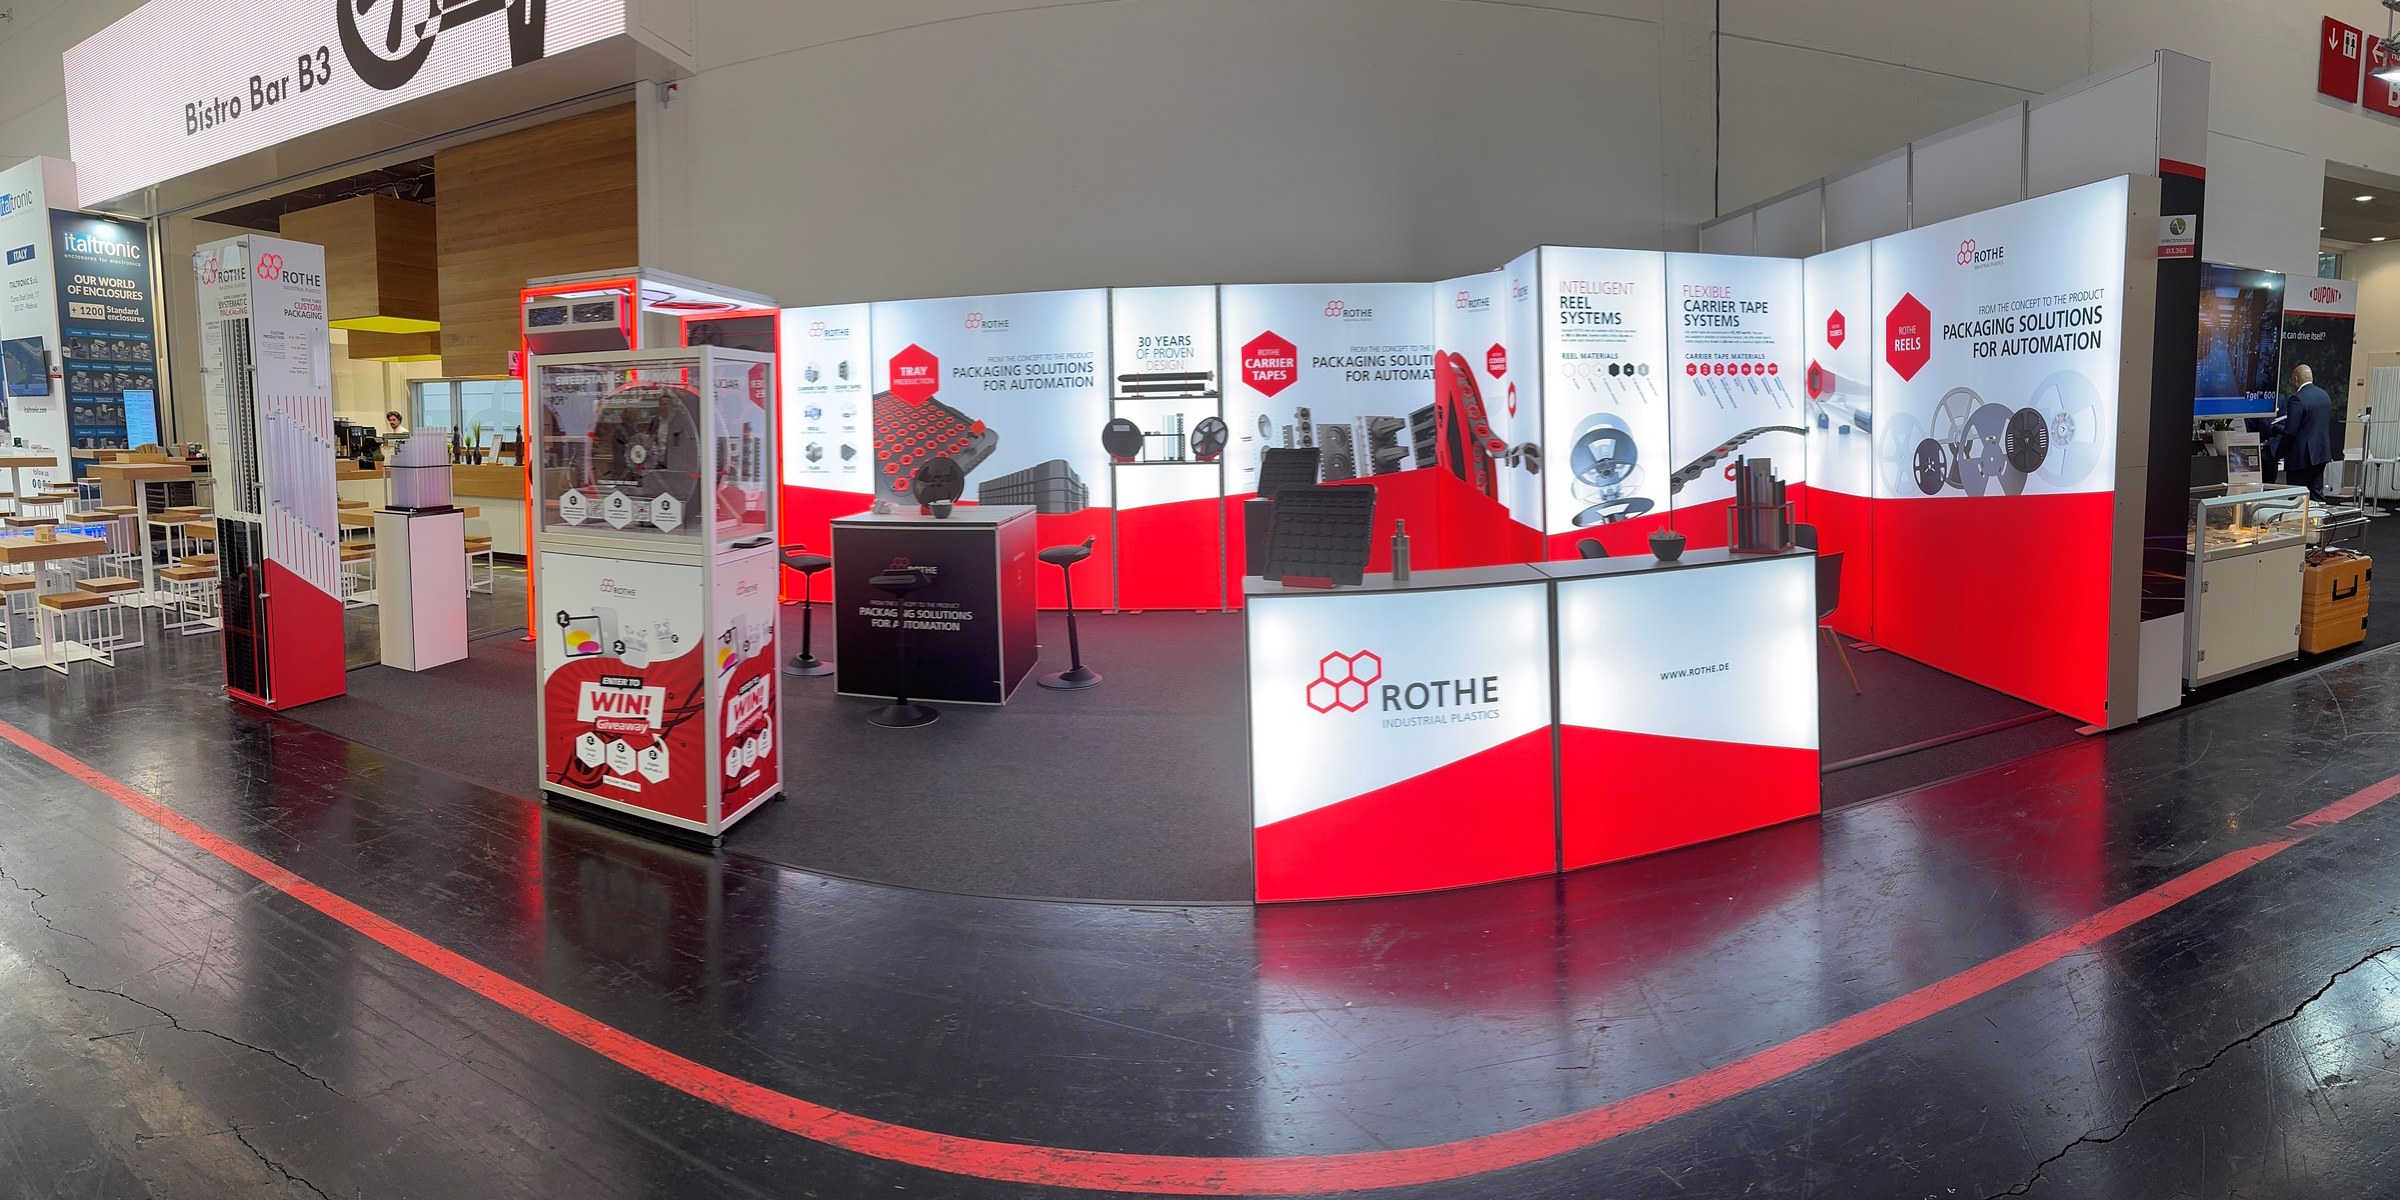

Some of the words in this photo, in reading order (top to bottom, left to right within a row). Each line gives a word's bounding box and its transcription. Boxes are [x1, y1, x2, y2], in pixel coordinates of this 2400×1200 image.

[185, 96, 241, 136] Bistro
[250, 75, 289, 112] Bar
[298, 46, 331, 92] B3
[64, 232, 140, 259] italtronic
[13, 248, 28, 261] ITALY
[64, 253, 97, 261] enclosures
[110, 258, 141, 267] electronics
[1974, 246, 2004, 263] ROTHE
[74, 274, 97, 285] OUR
[99, 276, 135, 289] WORLD
[218, 268, 245, 283] ROTHE
[282, 270, 320, 287] ROTHE
[68, 285, 82, 295] OF
[83, 286, 143, 300] ENCLOSURES
[1560, 281, 1634, 294] INTELLIGENT
[1683, 285, 1731, 298] FLEXIBLE
[1978, 306, 1996, 315] FROM
[1998, 303, 2009, 313] THE
[2011, 298, 2040, 311] CONCEPT
[2043, 297, 2052, 306] TO
[2054, 294, 2067, 305] THE
[2069, 288, 2104, 302] PRODUCT
[2312, 286, 2339, 304] DUPONT
[219, 298, 247, 309] SYSTEMATC
[294, 302, 322, 312] CUSTOM
[1468, 298, 1490, 308] ROTHE
[1560, 296, 1591, 309] REEL
[1684, 300, 1736, 313] CARRIER
[1739, 301, 1768, 313] TAPE
[80, 306, 103, 316] 1200
[106, 305, 139, 316] Standard
[220, 307, 247, 316] PACKAGING
[284, 309, 322, 320] PACKAGING
[1343, 309, 1372, 318] ROTHE
[107, 314, 145, 323] enclosures
[981, 320, 1009, 329] ROTHE
[1561, 311, 1621, 325] SYSTEMS
[1684, 314, 1740, 327] SYSTEMS
[1943, 316, 2014, 340] PACKAGING
[2019, 305, 2102, 332] SOLUTIONS
[824, 328, 849, 336] ROTHE
[1899, 325, 1916, 335] ROTHE
[2297, 331, 2310, 340] drive
[2311, 332, 2326, 340] itself?
[1138, 337, 1151, 347] 30
[1155, 336, 1191, 346] YEARS
[1895, 337, 1920, 351] REELS
[1973, 341, 1997, 358] FOR
[2001, 330, 2101, 356] AUTOMATION
[1136, 349, 1150, 359] OF
[1153, 347, 1194, 358] PROVEN
[1147, 360, 1184, 370] DESIGN
[1245, 358, 1294, 369] CARRIER
[1312, 355, 1385, 368] PACKAGING
[1390, 355, 1433, 366] SOLUTI
[900, 366, 928, 376] TRAY
[953, 364, 1021, 378] PACKAGING
[1025, 362, 1094, 375] SOLUTIONS
[1252, 370, 1287, 380] TAPES
[1346, 370, 1370, 381] FOR
[1374, 369, 1436, 380] AUTOMAT
[555, 374, 624, 385] SWEEPSTAS:
[984, 380, 1006, 391] FOR
[1010, 376, 1094, 390] AUTOMATION
[2264, 391, 2275, 399] 600
[614, 587, 636, 596] ROTHE
[859, 607, 916, 618] PACKAGG
[917, 610, 973, 620] SOLUTIONS
[871, 619, 891, 628] FOR
[1660, 663, 1730, 680] WWW.ROTHE.DE
[1382, 675, 1498, 712] ROTHE
[590, 691, 652, 715] WIN!
[1382, 714, 1448, 729] INDUSTRIAL
[1451, 709, 1500, 723] PLASTICS
[596, 720, 648, 733] Giveaway
